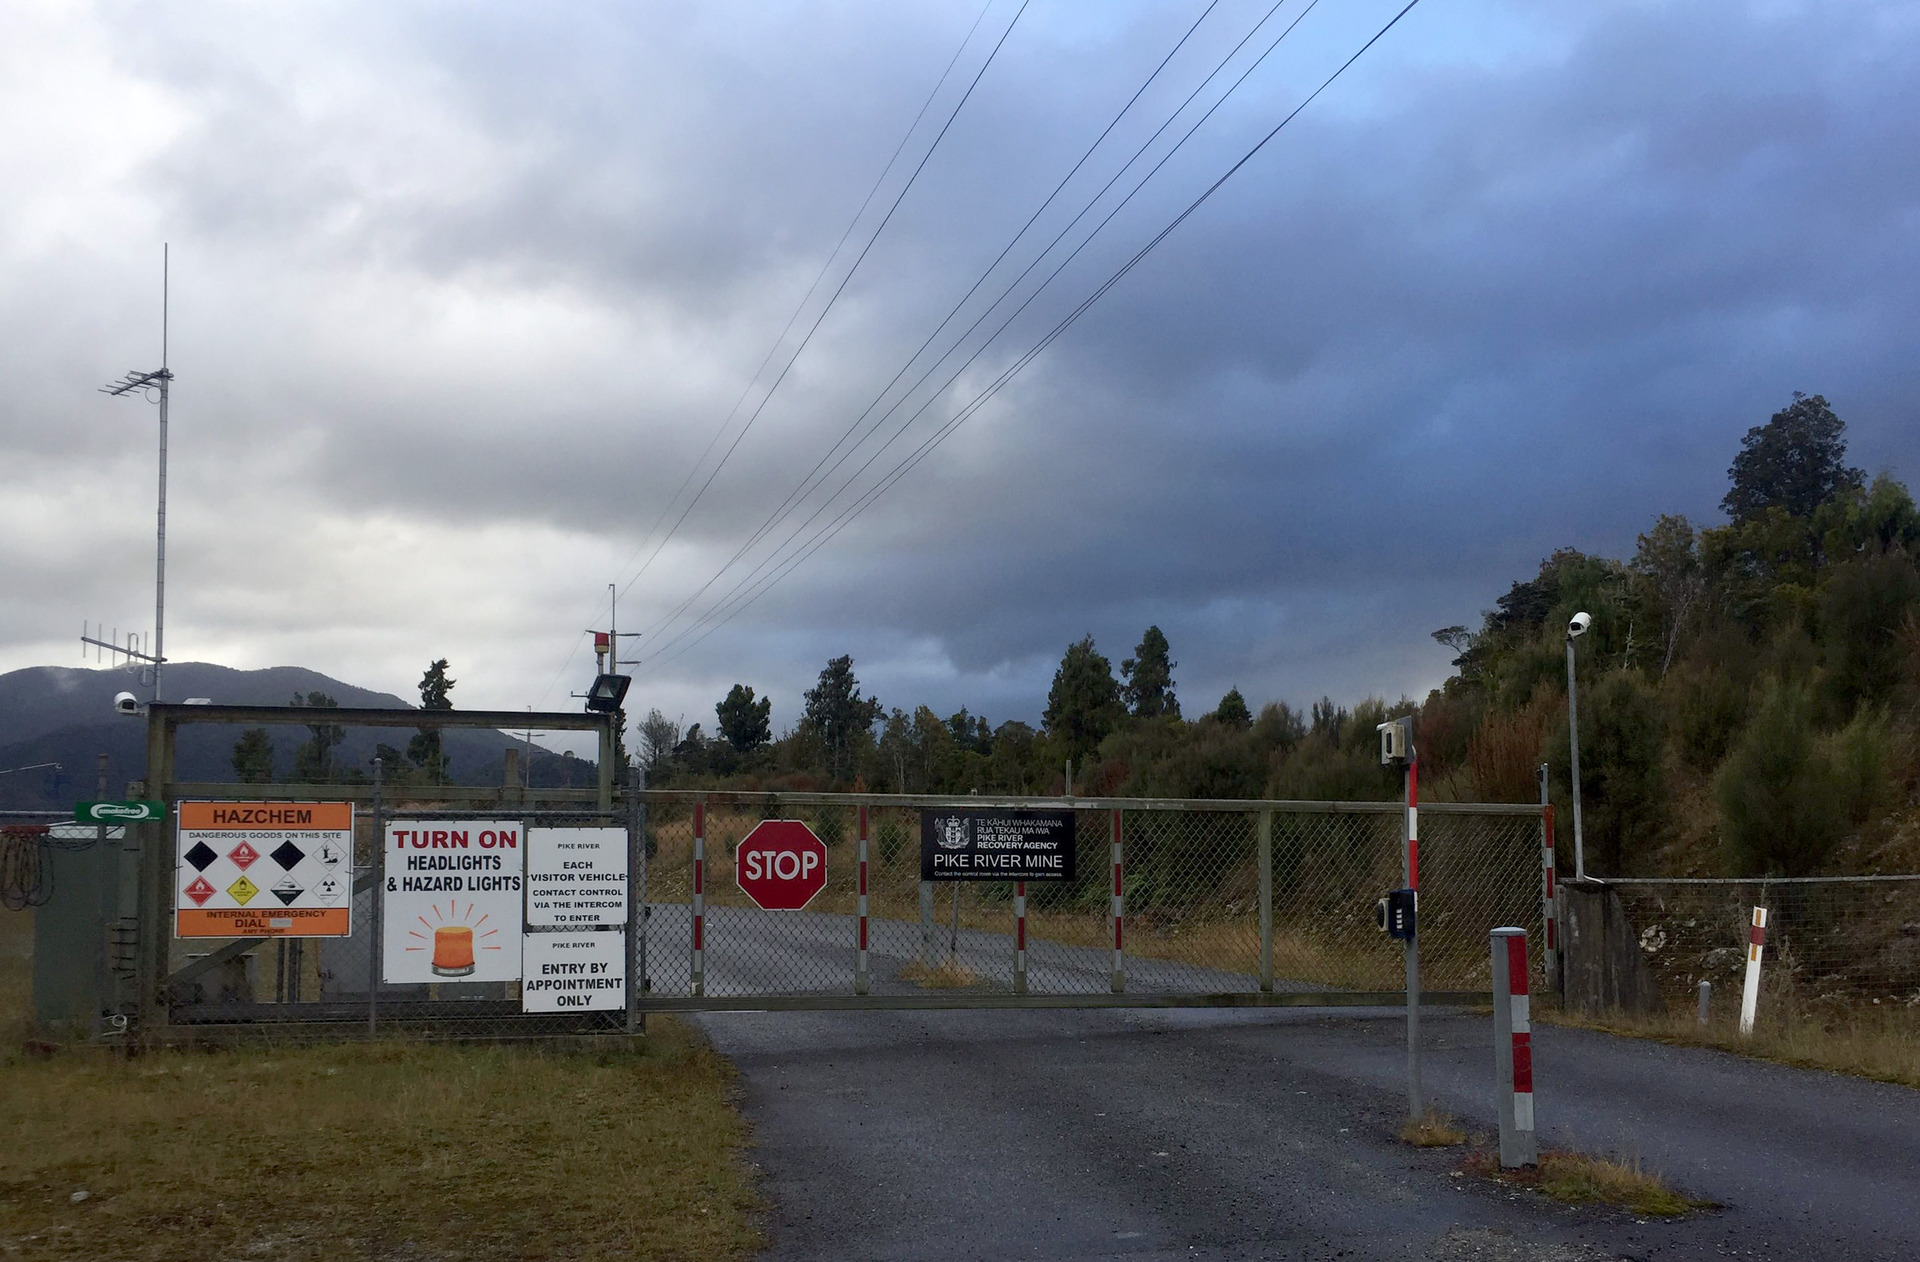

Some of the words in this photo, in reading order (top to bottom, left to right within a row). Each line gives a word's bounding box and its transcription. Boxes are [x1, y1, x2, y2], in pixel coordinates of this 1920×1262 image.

[213, 809, 312, 824] HAZCHEM
[975, 818, 986, 826] TE
[1012, 819, 1063, 828] WHAKAMANA
[977, 826, 994, 834] RUA
[994, 826, 1020, 835] TEKAU
[392, 830, 469, 849] TURN
[478, 830, 517, 849] ON
[998, 834, 1024, 842] RIVER
[977, 841, 1023, 849] RECOVERY
[407, 855, 501, 870] HEADLIGHTS
[563, 861, 593, 870] EACH
[745, 850, 819, 881] STOP
[934, 854, 969, 867] PIKE
[974, 854, 1022, 868] RIVER
[1025, 855, 1063, 868] MINE
[531, 873, 575, 882] VISITOR
[578, 873, 625, 881] VEHICLE
[387, 876, 398, 892] &
[403, 876, 463, 891] HAZARD
[468, 876, 520, 891] LIGHTS
[532, 889, 576, 897] CONTACT
[534, 901, 550, 909] VIA
[206, 911, 259, 919] INTERNAL
[261, 910, 327, 918] EMERGENCY
[554, 914, 567, 922] TO
[569, 914, 600, 922] ENTER
[235, 919, 266, 928] DIAL
[542, 963, 586, 975] ENTRY
[590, 962, 608, 974] BY
[526, 978, 622, 991] APPOINTMENT
[556, 995, 592, 1007] ONLY
